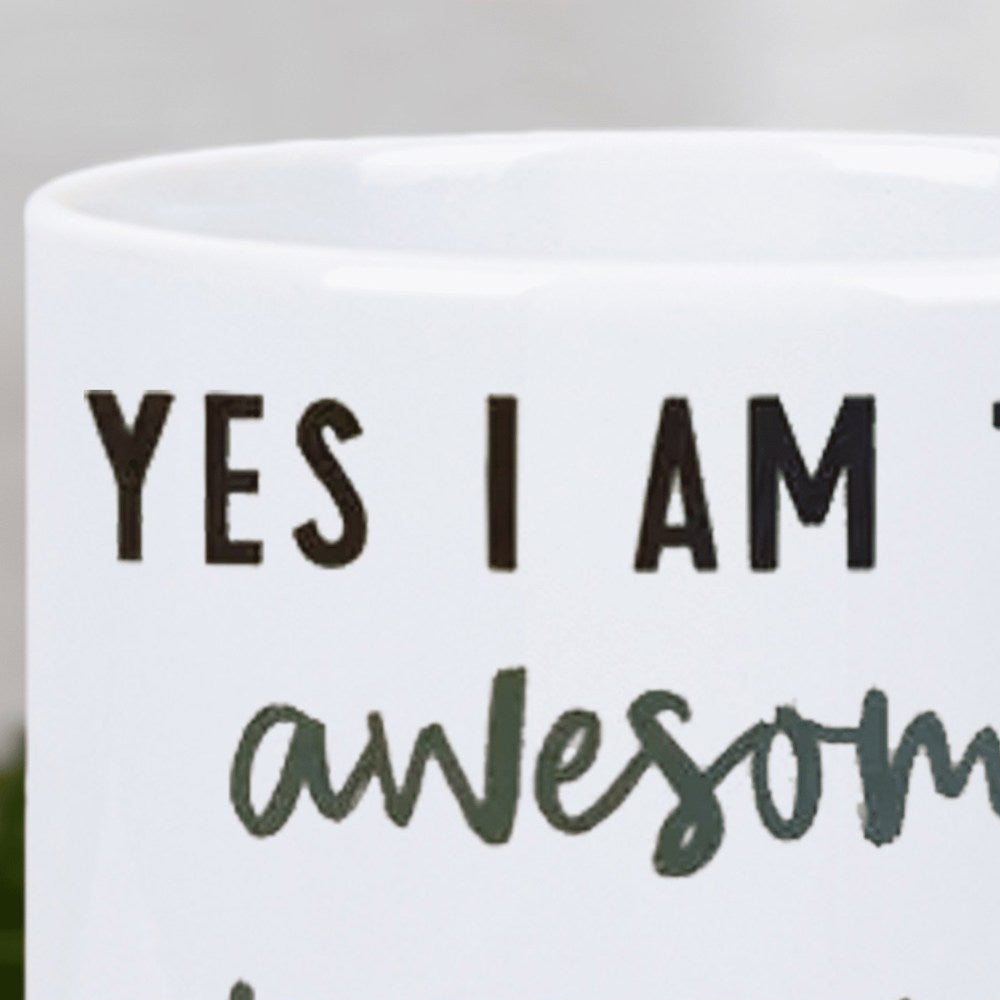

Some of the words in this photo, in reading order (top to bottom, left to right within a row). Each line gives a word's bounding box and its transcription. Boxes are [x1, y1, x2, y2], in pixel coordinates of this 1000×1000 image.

[85, 389, 368, 570] YES
[486, 394, 518, 573] I
[633, 393, 877, 573] AM
